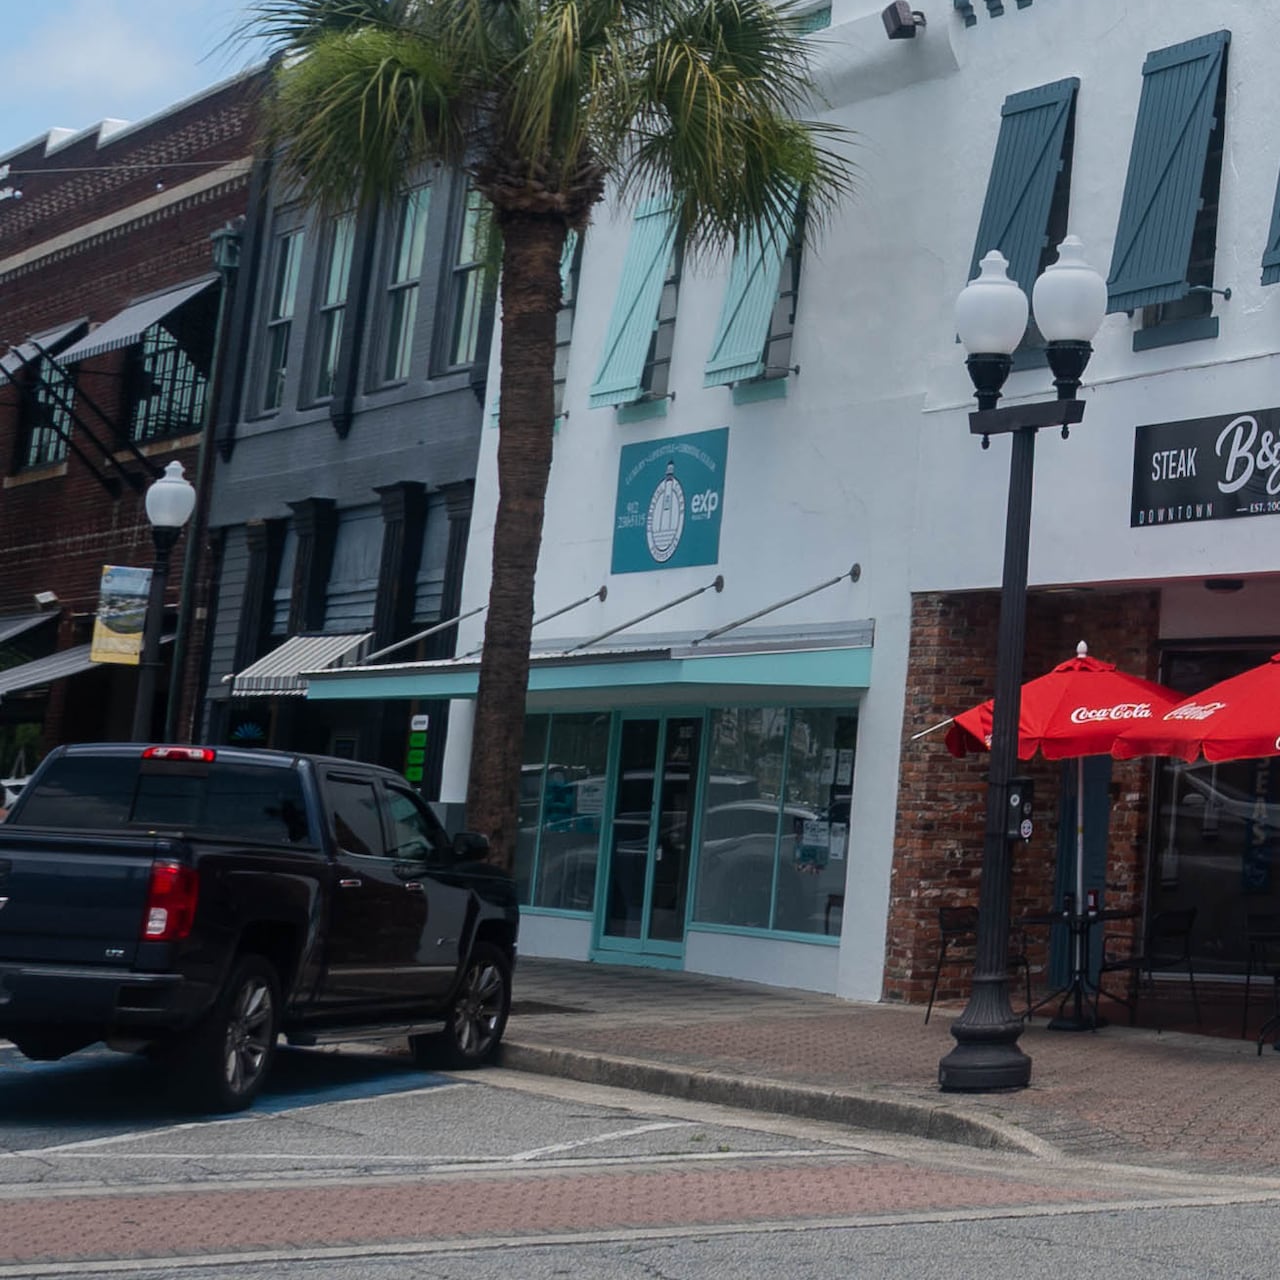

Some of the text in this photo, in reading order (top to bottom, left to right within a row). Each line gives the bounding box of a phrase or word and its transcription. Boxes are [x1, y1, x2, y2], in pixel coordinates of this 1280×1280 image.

[1152, 448, 1197, 481] STEAK
[1139, 504, 1214, 524] DOWNTOWN
[1070, 703, 1152, 724] Coca-Cola
